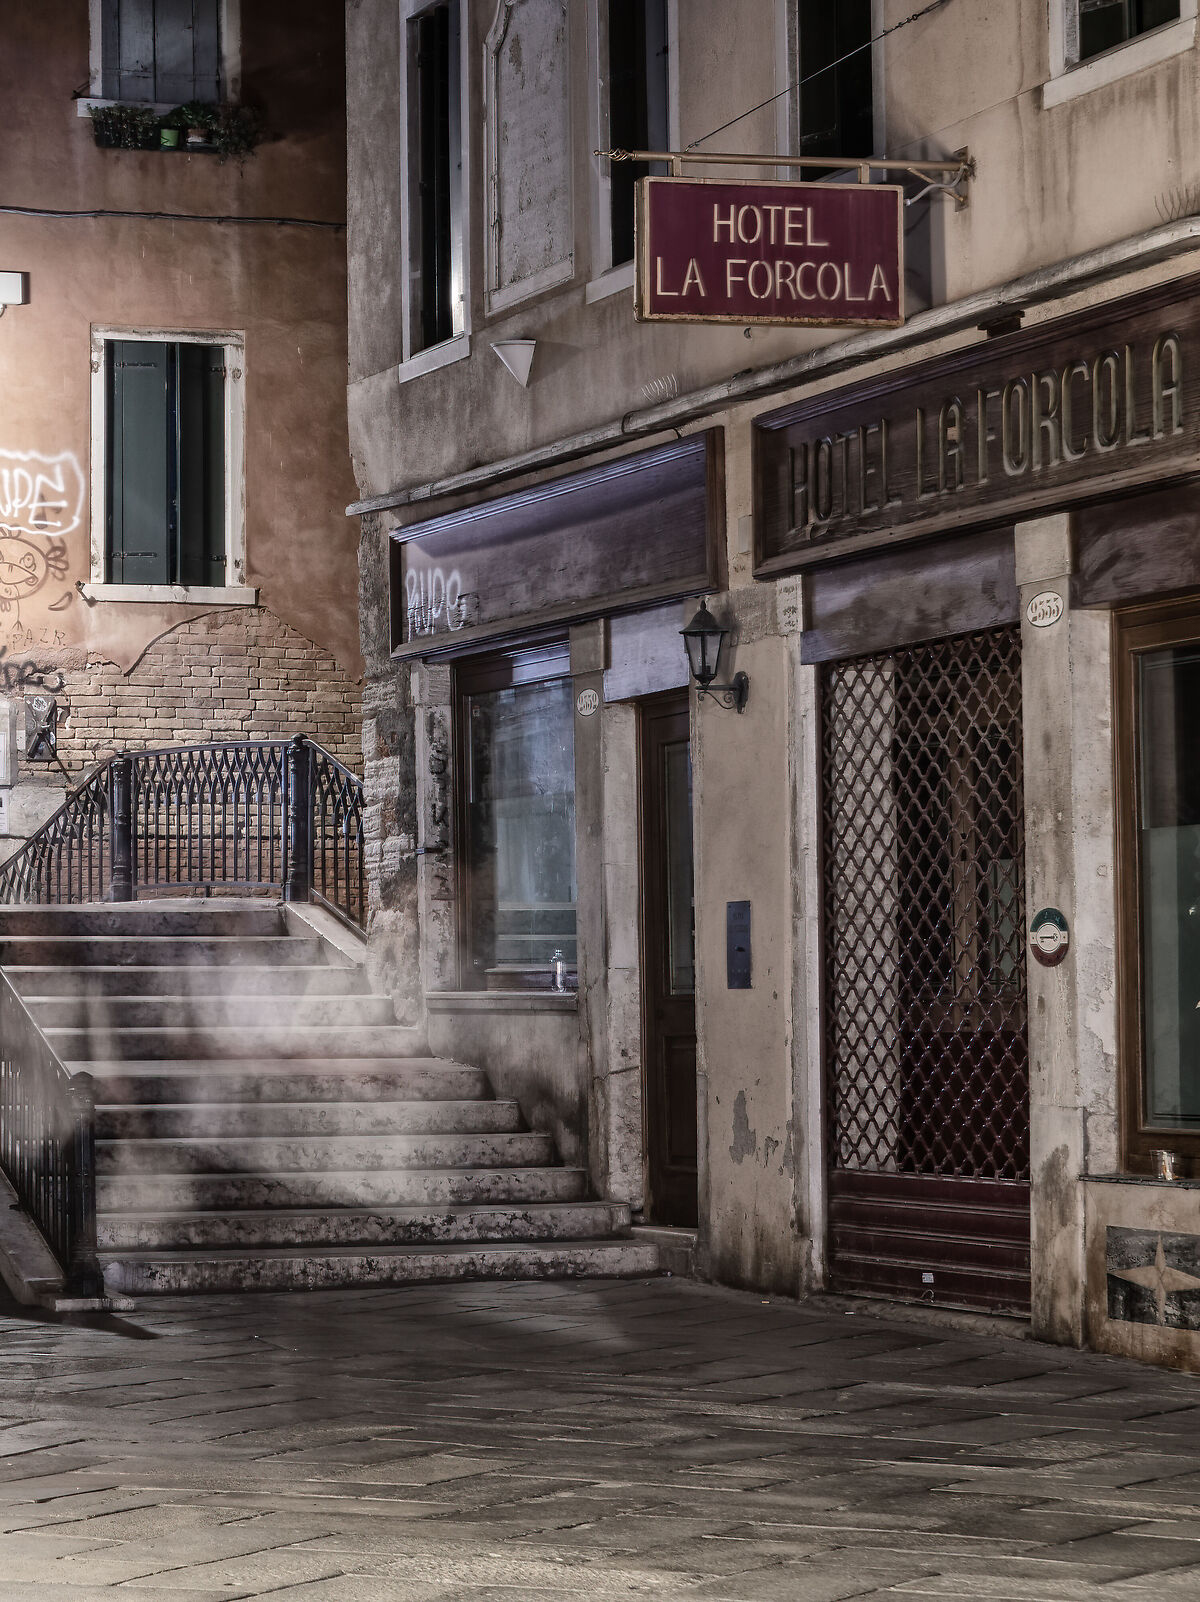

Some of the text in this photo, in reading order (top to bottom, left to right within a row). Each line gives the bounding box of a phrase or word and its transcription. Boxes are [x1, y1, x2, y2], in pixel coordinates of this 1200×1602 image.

[713, 203, 830, 247] HOTEL
[656, 256, 892, 302] LA FORCOLA
[785, 331, 1185, 538] HOTEL LA FORCOLA
